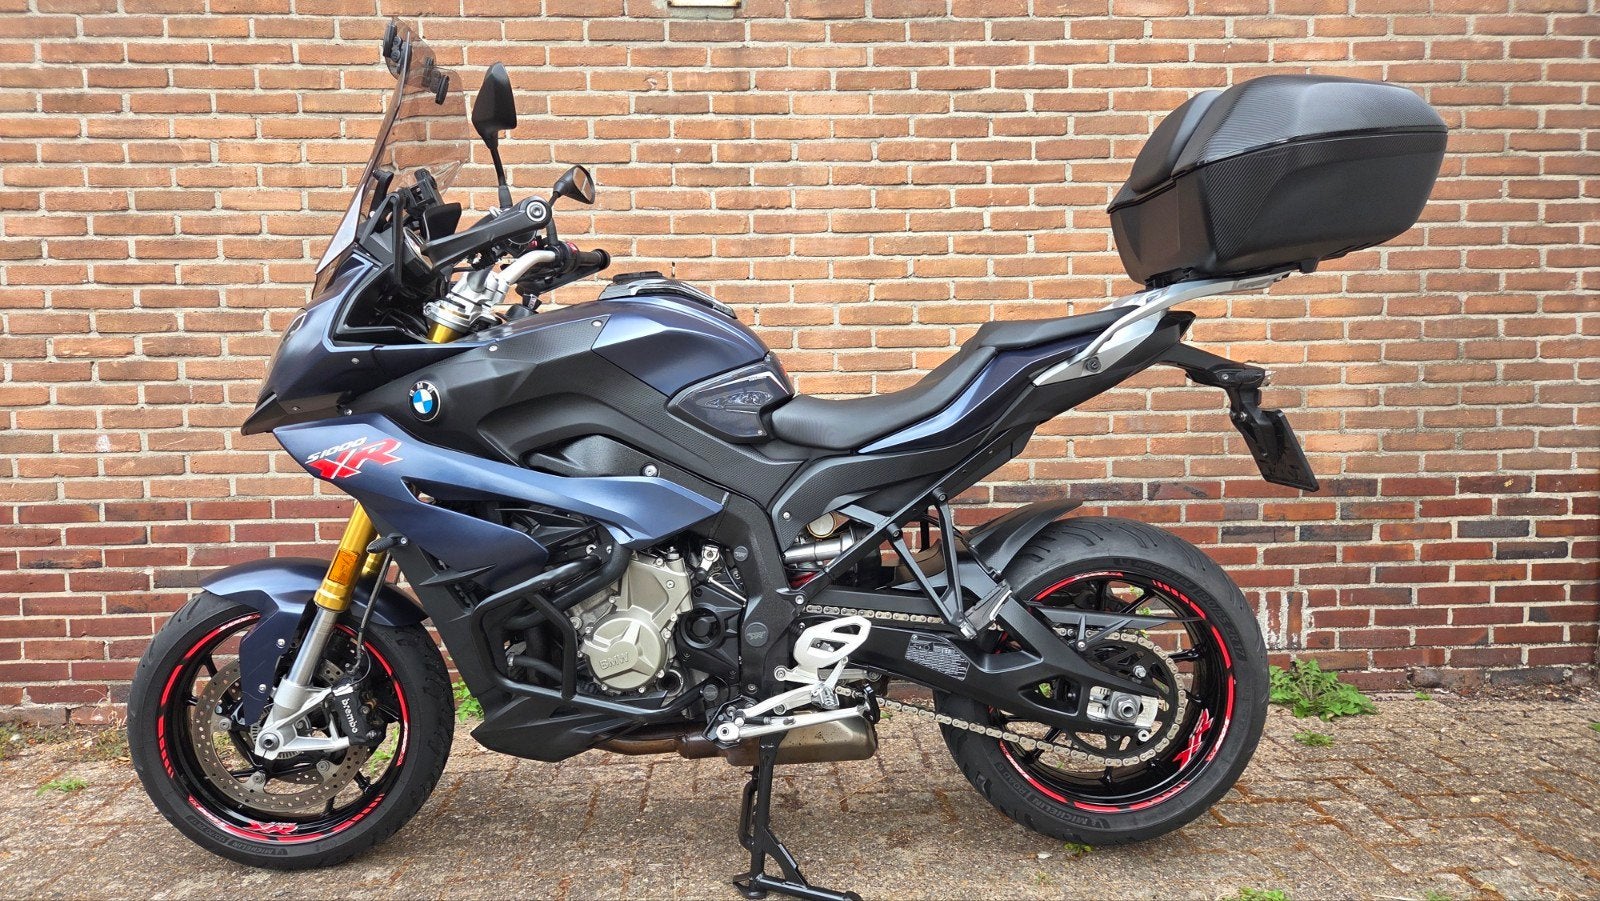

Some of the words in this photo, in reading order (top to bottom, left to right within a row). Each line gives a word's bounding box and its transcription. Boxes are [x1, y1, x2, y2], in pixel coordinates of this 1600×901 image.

[305, 437, 367, 464] S1000
[308, 438, 403, 479] XR
[599, 652, 629, 670] BMW
[341, 698, 358, 733] brembo
[1001, 769, 1028, 795] ROAD
[1029, 796, 1088, 825] MICHELIN
[231, 840, 274, 855] MICHELIN
